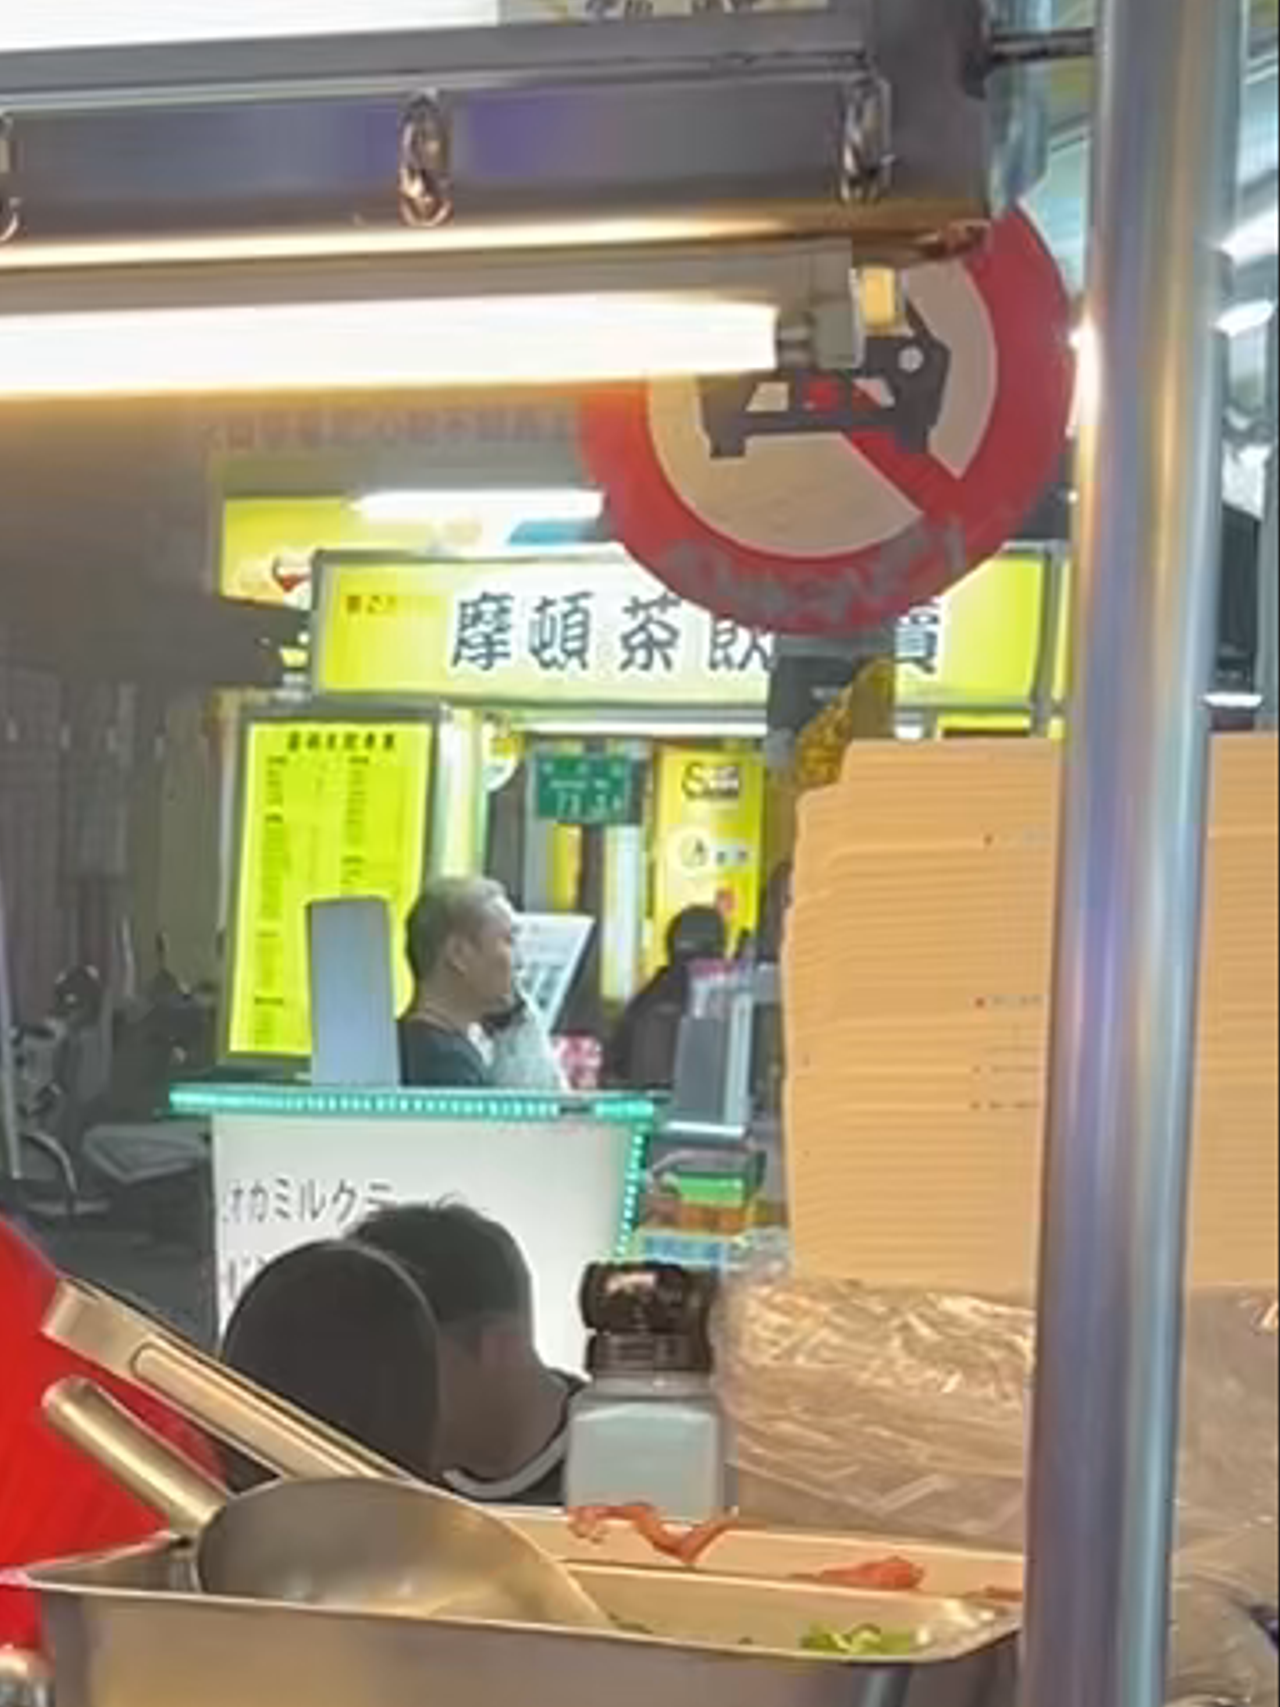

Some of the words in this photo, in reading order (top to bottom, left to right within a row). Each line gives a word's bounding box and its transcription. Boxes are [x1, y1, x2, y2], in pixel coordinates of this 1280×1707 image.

[450, 591, 942, 675] 摩頓茶飲賣
